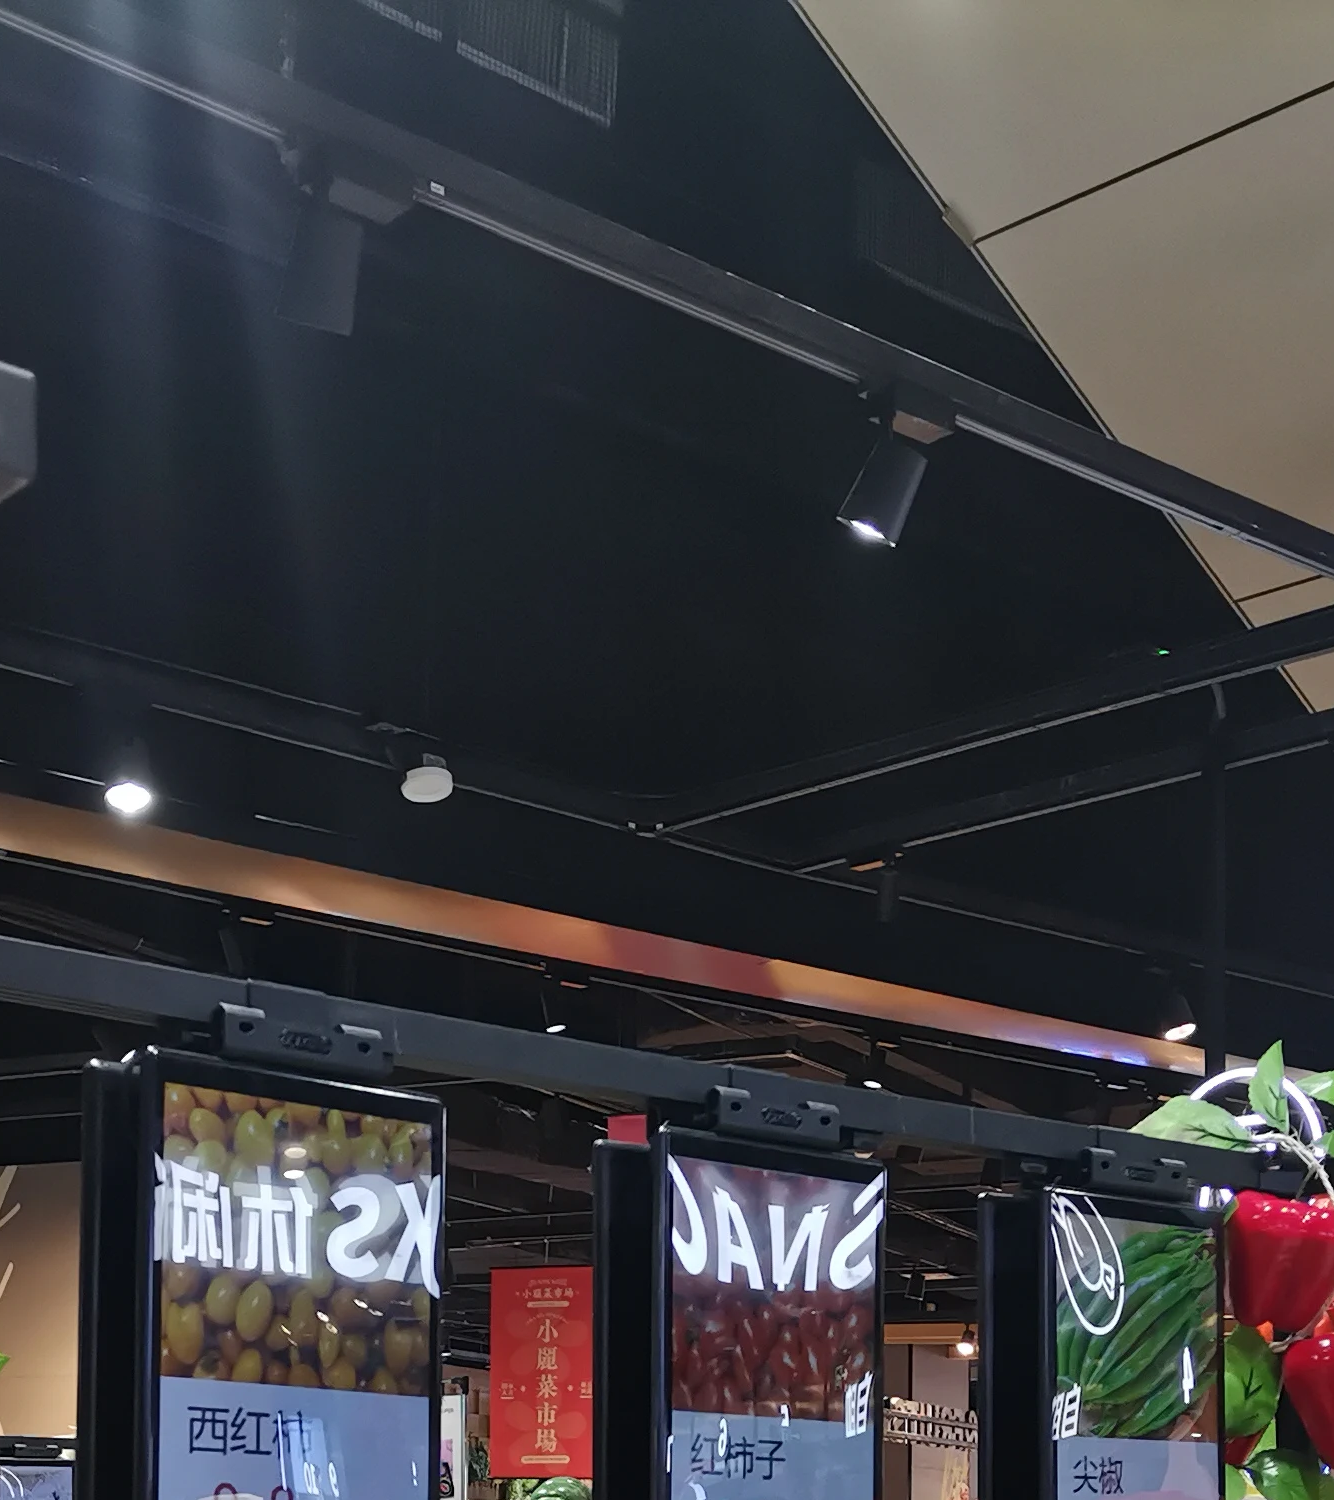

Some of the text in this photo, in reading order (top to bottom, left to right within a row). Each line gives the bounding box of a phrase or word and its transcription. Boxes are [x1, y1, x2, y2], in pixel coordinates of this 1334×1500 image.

[535, 1319, 559, 1453] 小麗菜市場
[691, 1434, 786, 1480] 红柿子
[1073, 1456, 1124, 1494] 尖椒
